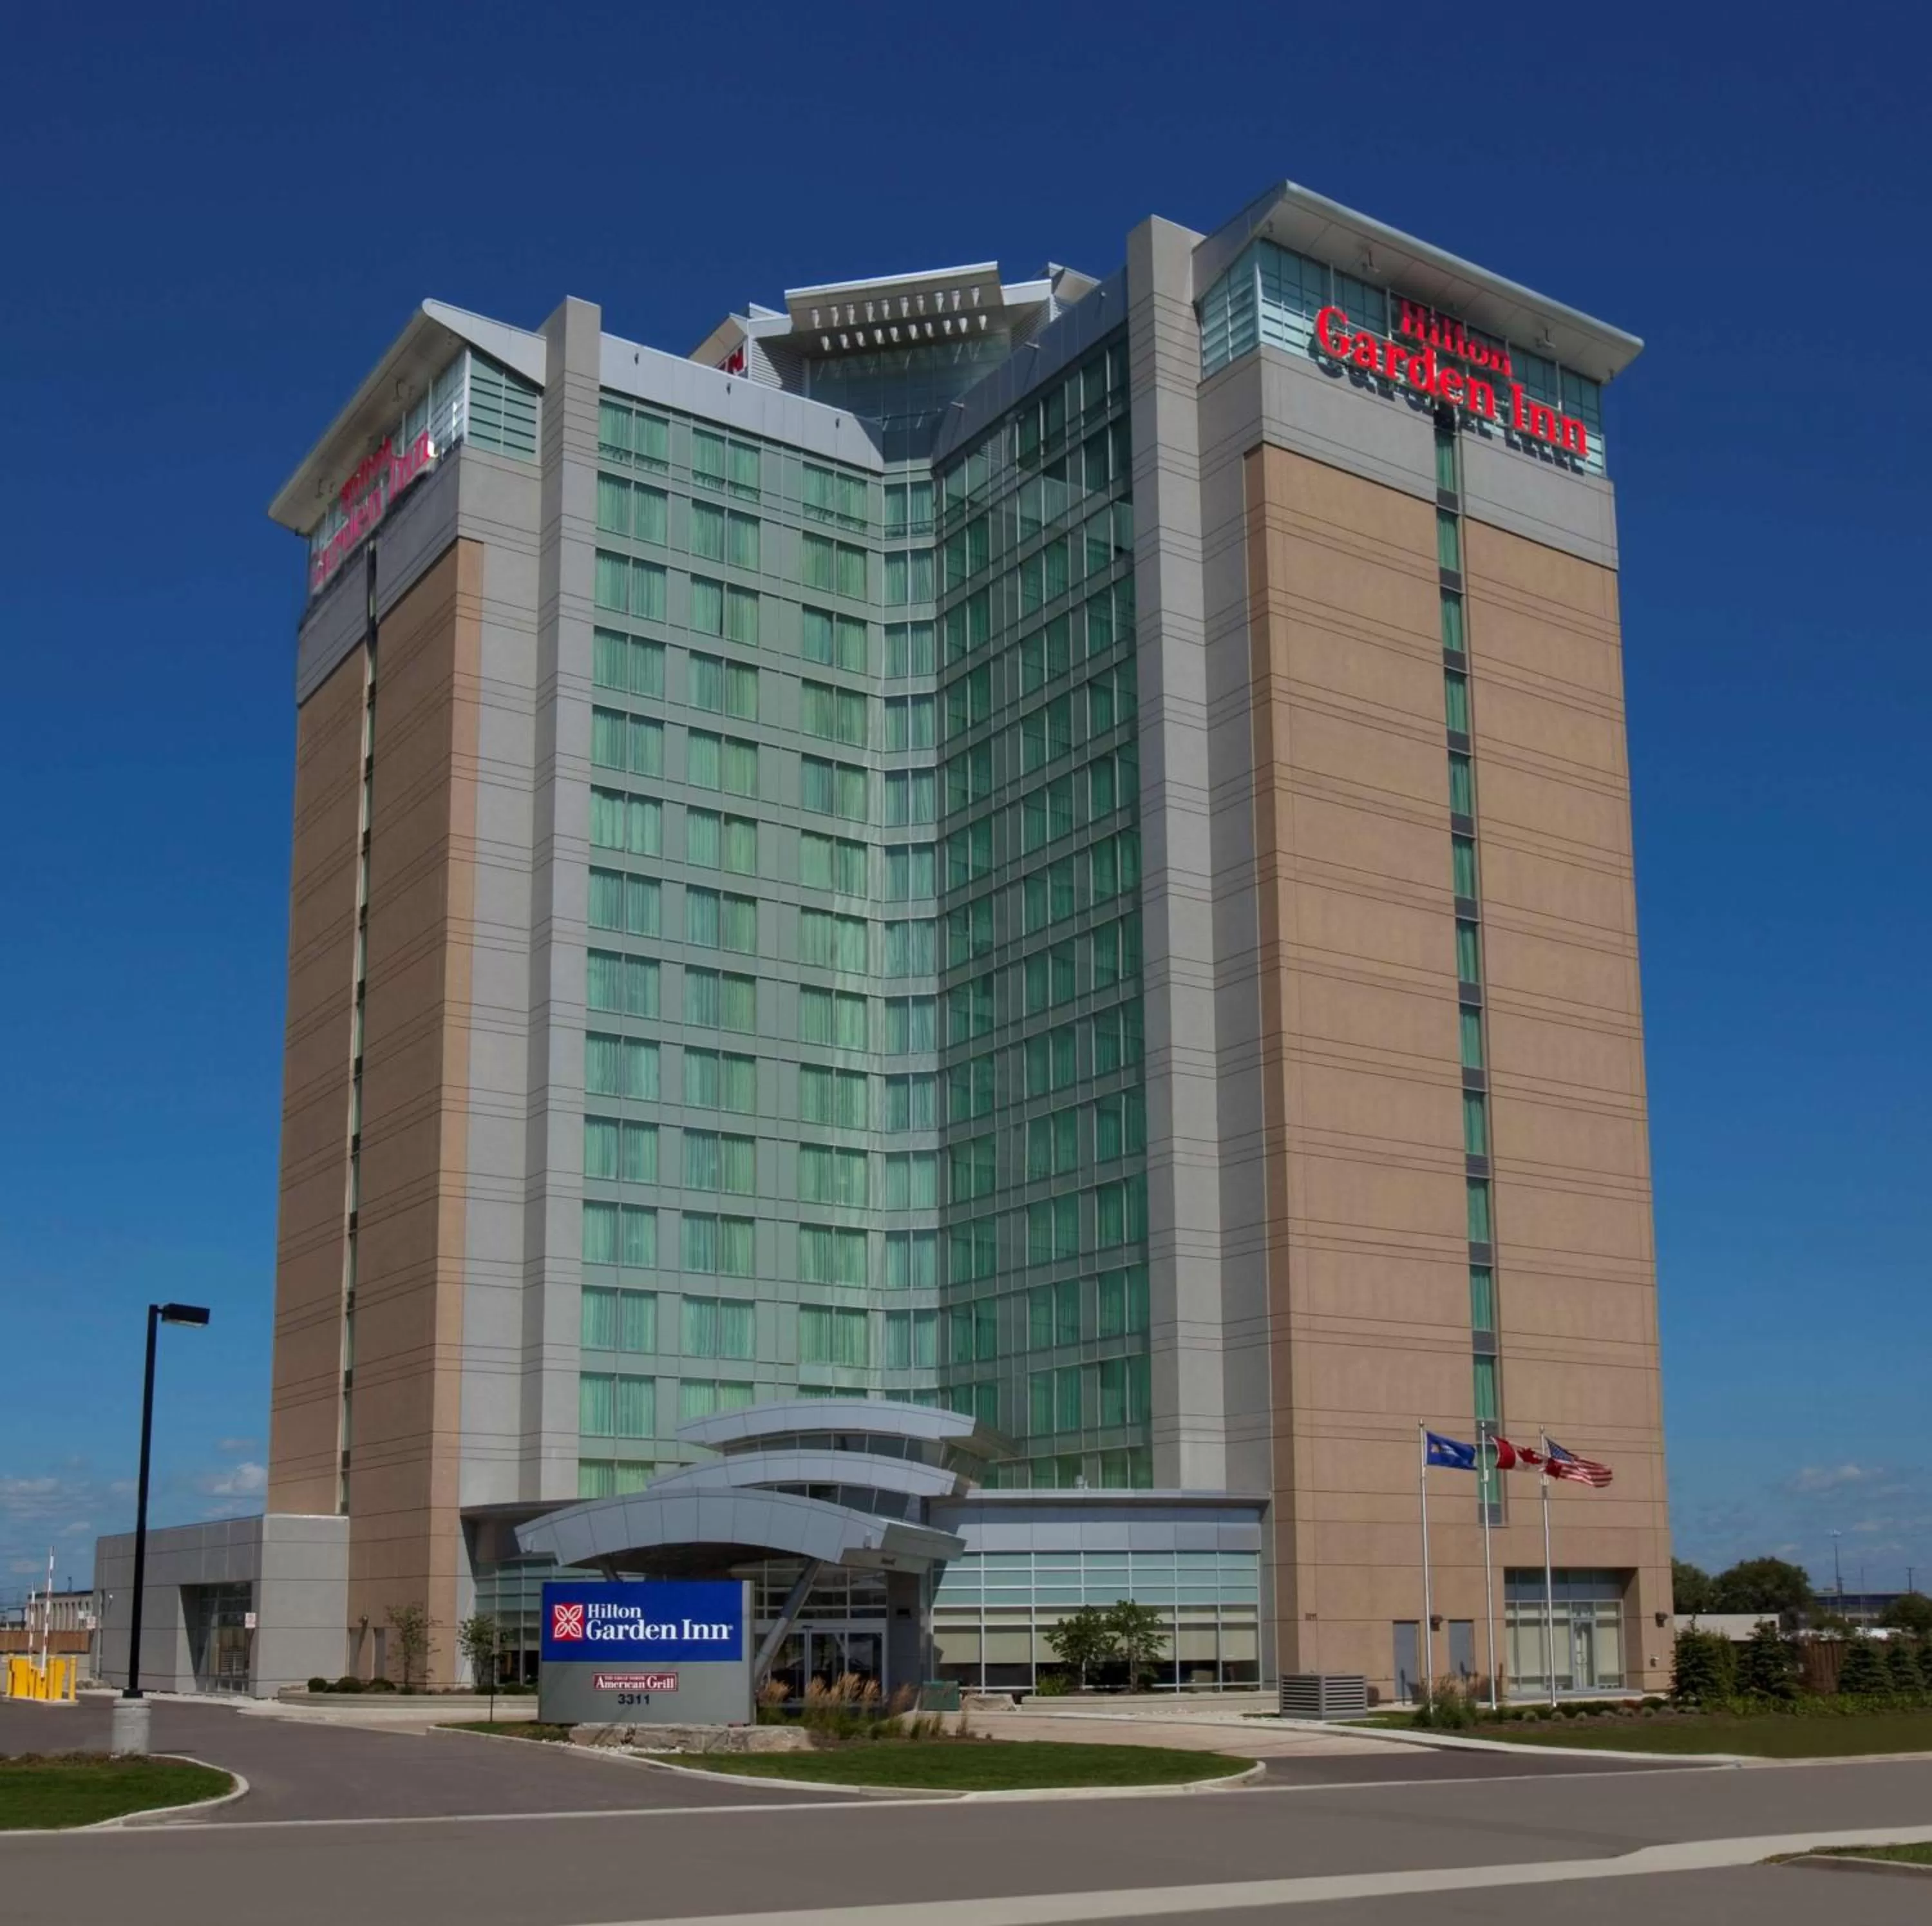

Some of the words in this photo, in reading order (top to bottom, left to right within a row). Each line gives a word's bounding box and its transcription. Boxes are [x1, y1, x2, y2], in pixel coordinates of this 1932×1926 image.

[1399, 298, 1512, 376] Hilton
[1315, 305, 1495, 420] Garden
[1510, 382, 1588, 455] Inn
[588, 1604, 641, 1618] Hilton
[586, 1619, 677, 1640] Garden
[681, 1619, 730, 1639] Inn
[596, 1675, 644, 1688] American
[647, 1675, 674, 1688] Grill
[618, 1693, 650, 1704] 3311
